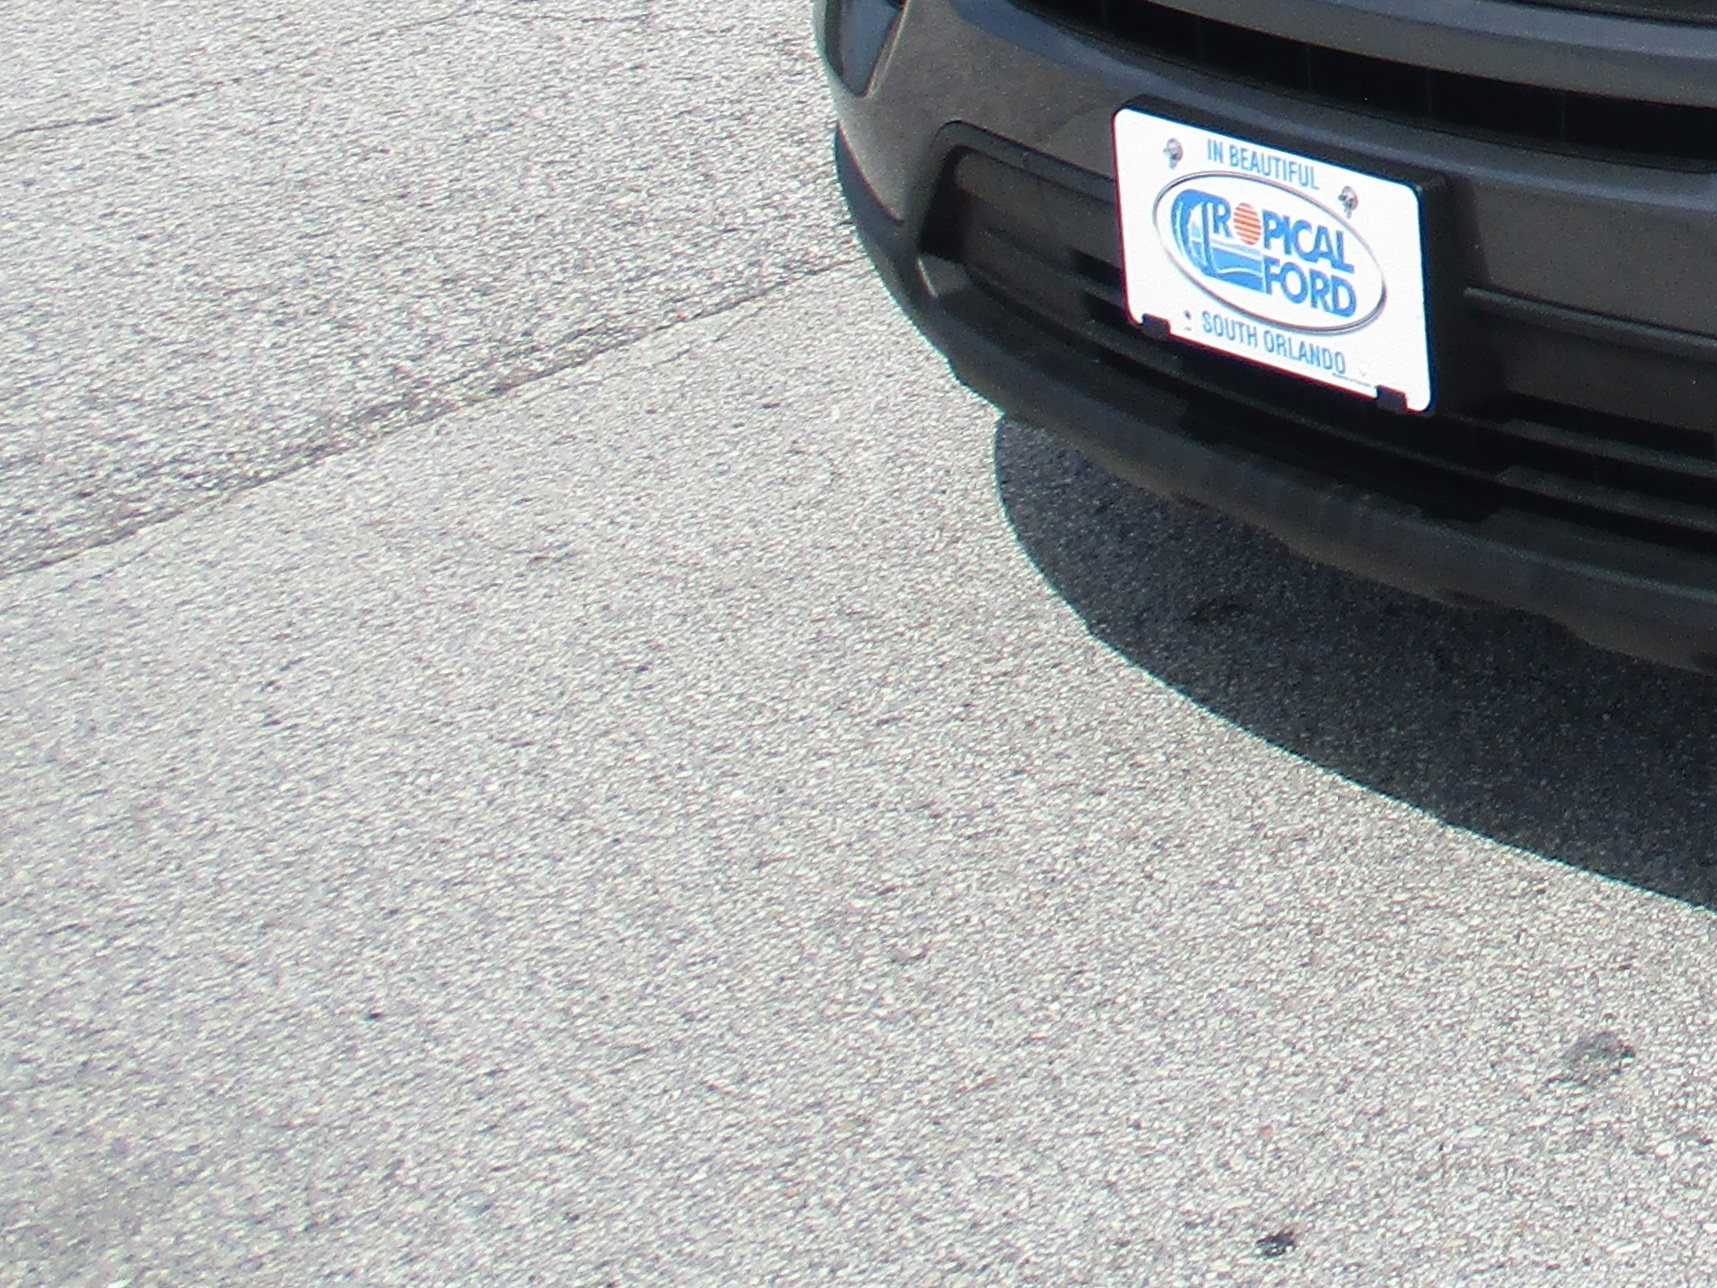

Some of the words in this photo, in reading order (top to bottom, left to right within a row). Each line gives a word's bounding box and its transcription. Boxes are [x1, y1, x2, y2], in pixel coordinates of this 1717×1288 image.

[1207, 138, 1224, 163] IN
[1229, 144, 1320, 191] BEAUTIFUL
[1172, 189, 1355, 275] TROPICAL
[1263, 255, 1357, 319] FORD
[1201, 310, 1259, 349] SOUTH
[1263, 328, 1346, 375] ORLANDO
